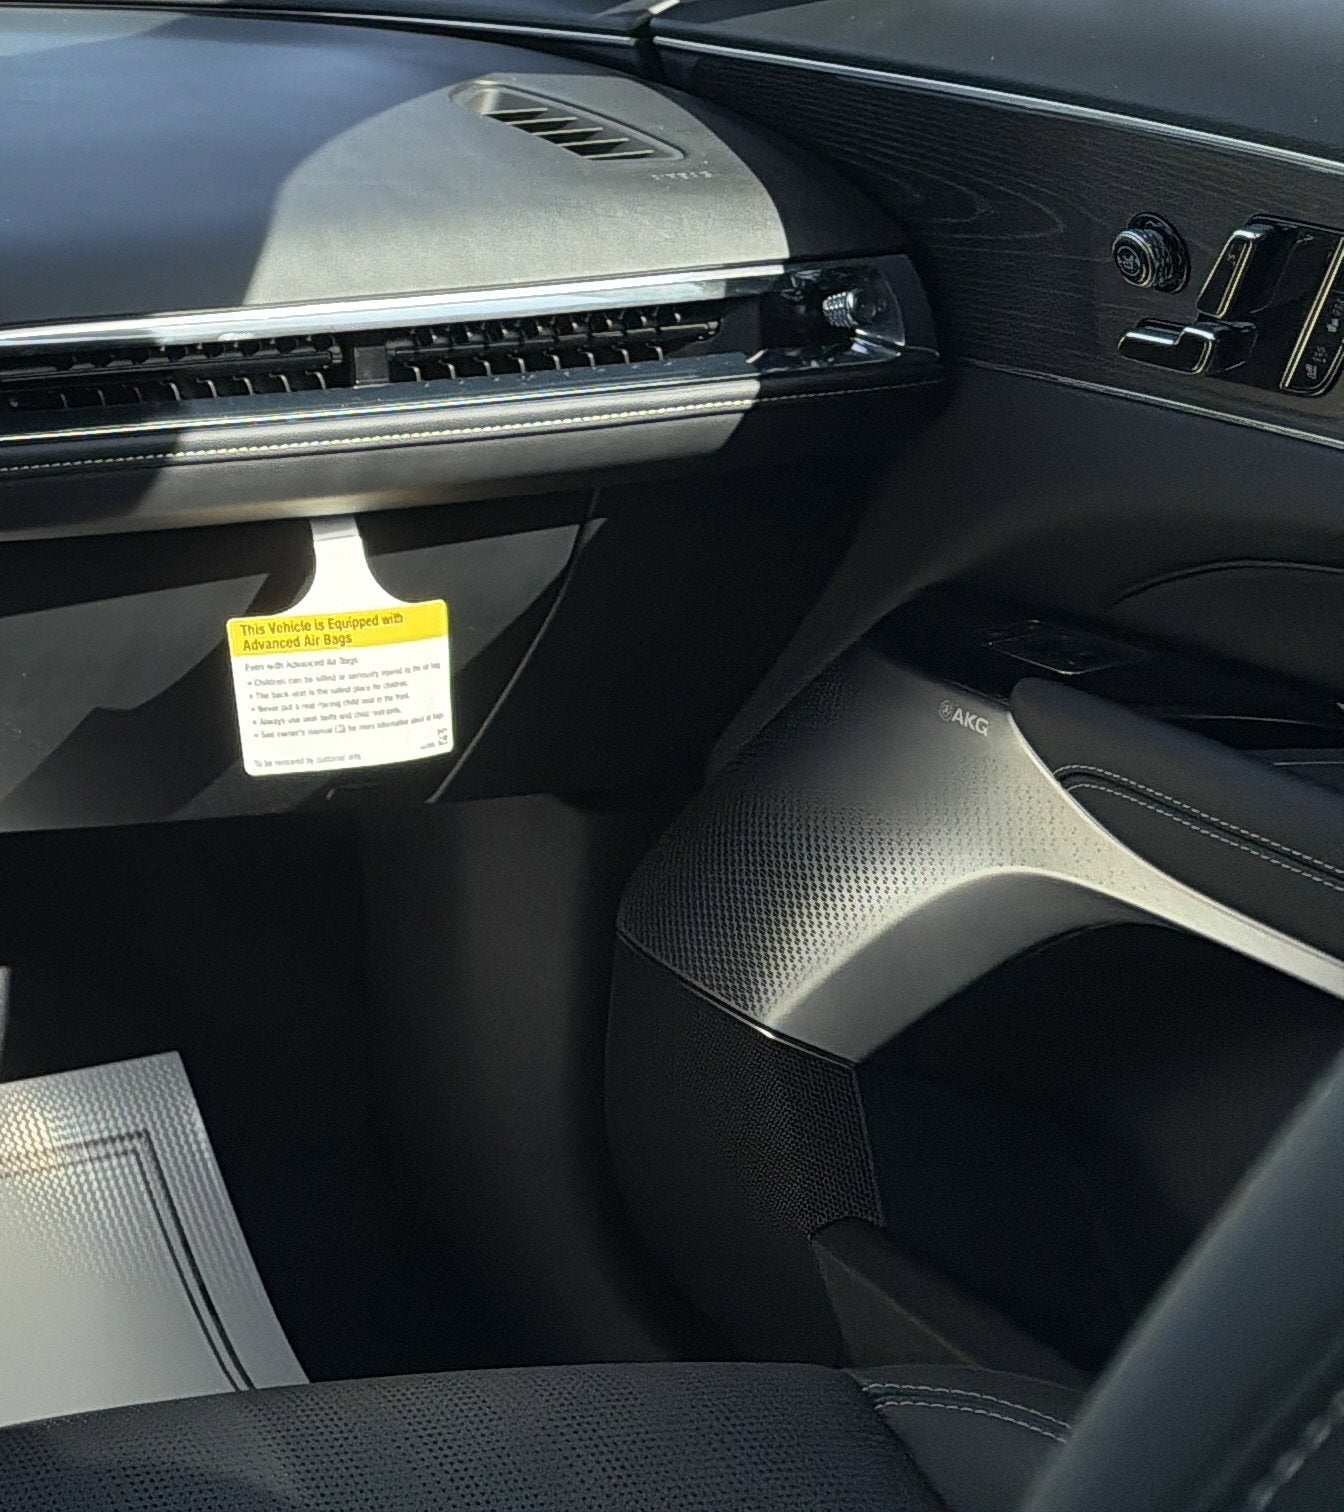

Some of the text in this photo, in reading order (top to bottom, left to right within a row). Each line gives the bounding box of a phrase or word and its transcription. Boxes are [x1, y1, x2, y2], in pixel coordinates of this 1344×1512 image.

[240, 612, 404, 636] This Vehicle is Equipped with
[243, 633, 353, 651] Advanced Air Bags
[952, 707, 990, 737] AKG
